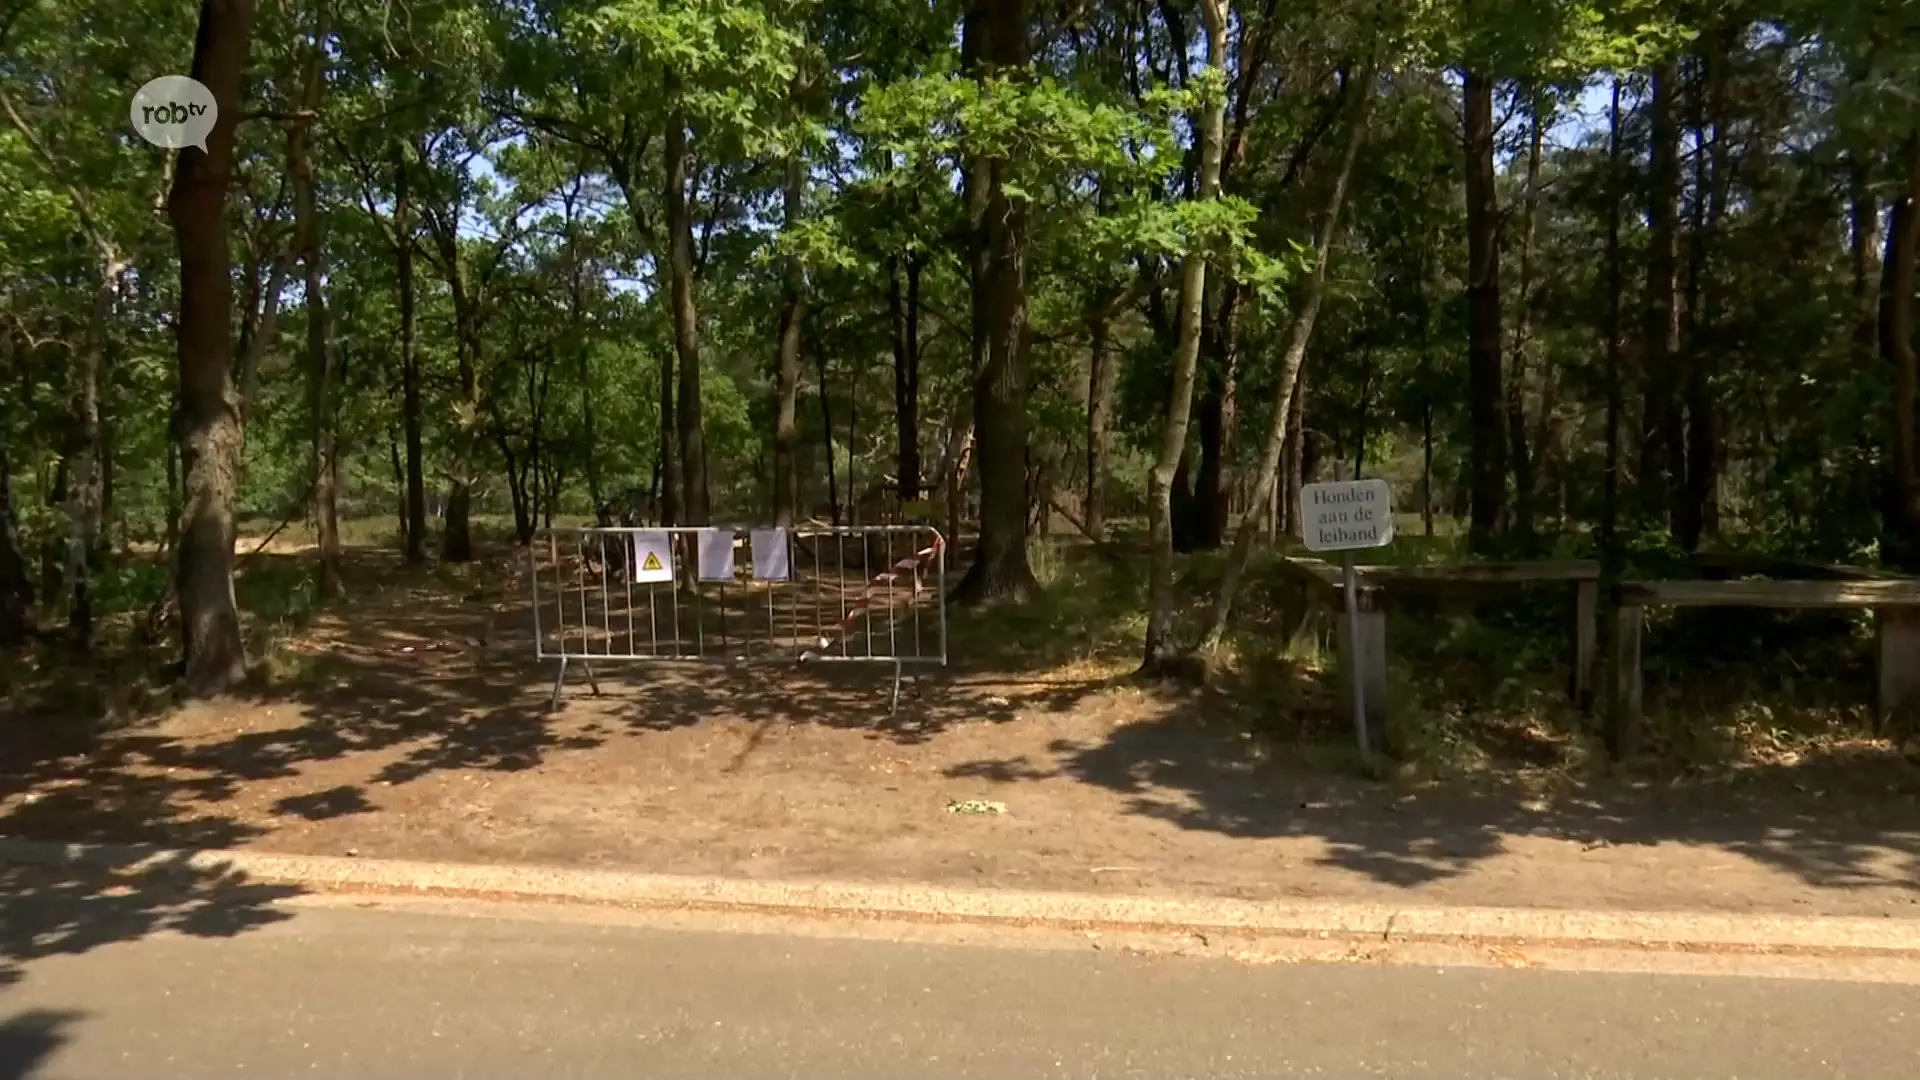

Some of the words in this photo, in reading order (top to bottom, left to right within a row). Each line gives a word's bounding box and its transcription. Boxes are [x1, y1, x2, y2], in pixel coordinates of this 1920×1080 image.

[1314, 488, 1375, 504] Honden
[1319, 511, 1348, 524] aan
[1354, 506, 1373, 520] de
[1319, 525, 1377, 543] leiband
